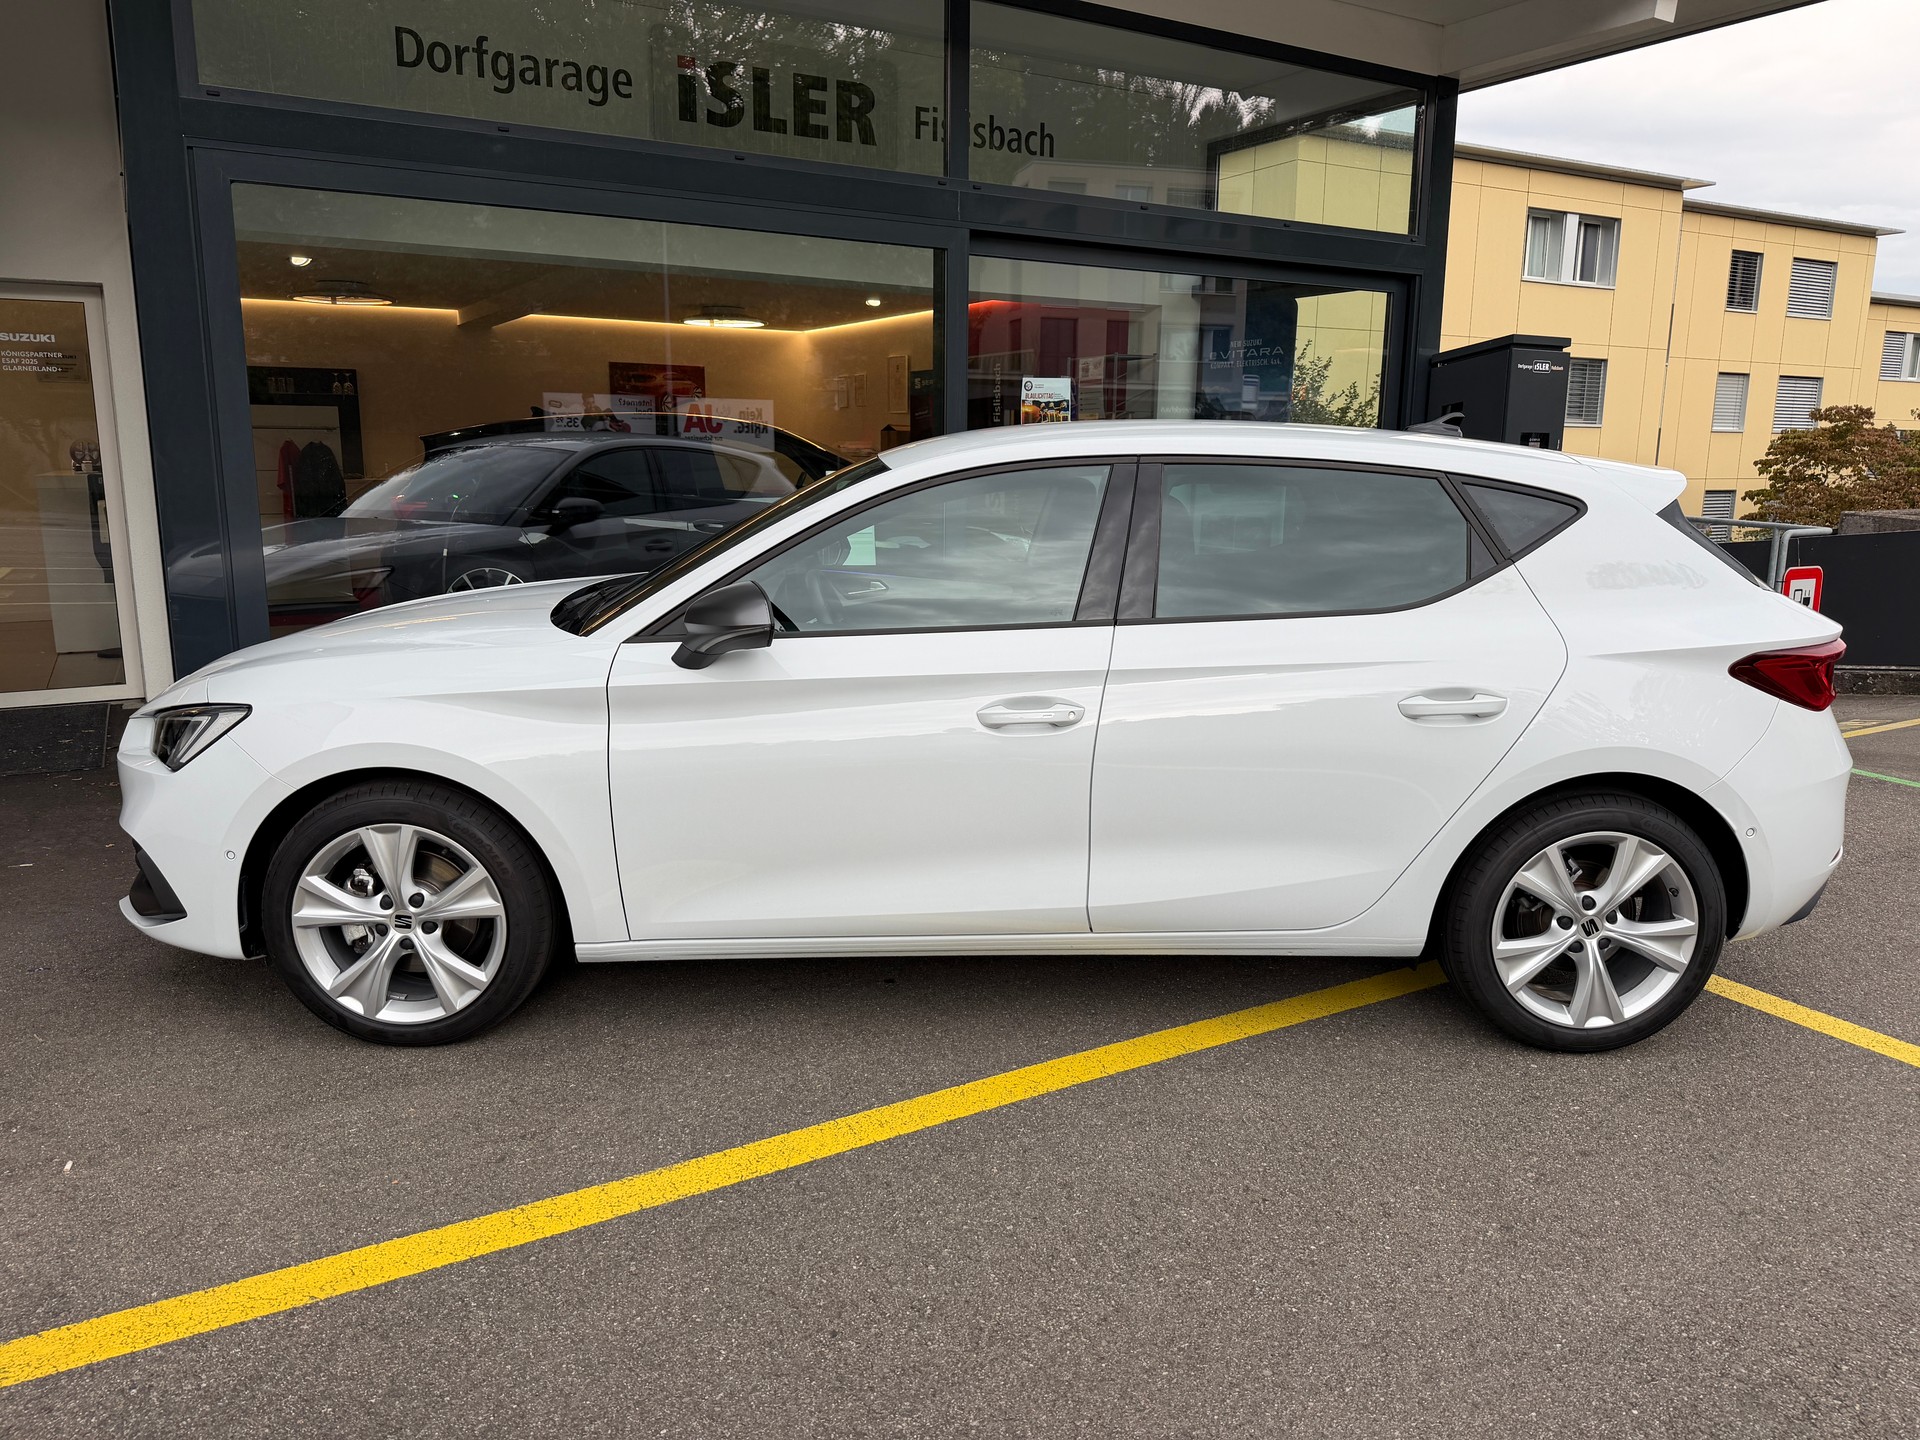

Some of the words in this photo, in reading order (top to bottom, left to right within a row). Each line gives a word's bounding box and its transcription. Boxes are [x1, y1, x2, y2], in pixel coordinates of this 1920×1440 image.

[395, 26, 633, 107] Dorfgarage
[914, 105, 1055, 158] Fisbach
[0, 332, 56, 342] SUZUKI
[1242, 338, 1263, 347] SUZUKI
[0, 350, 63, 358] KÖNIGSPARTNER
[1219, 346, 1284, 359] VITARA
[992, 362, 1001, 423] Fislisbach
